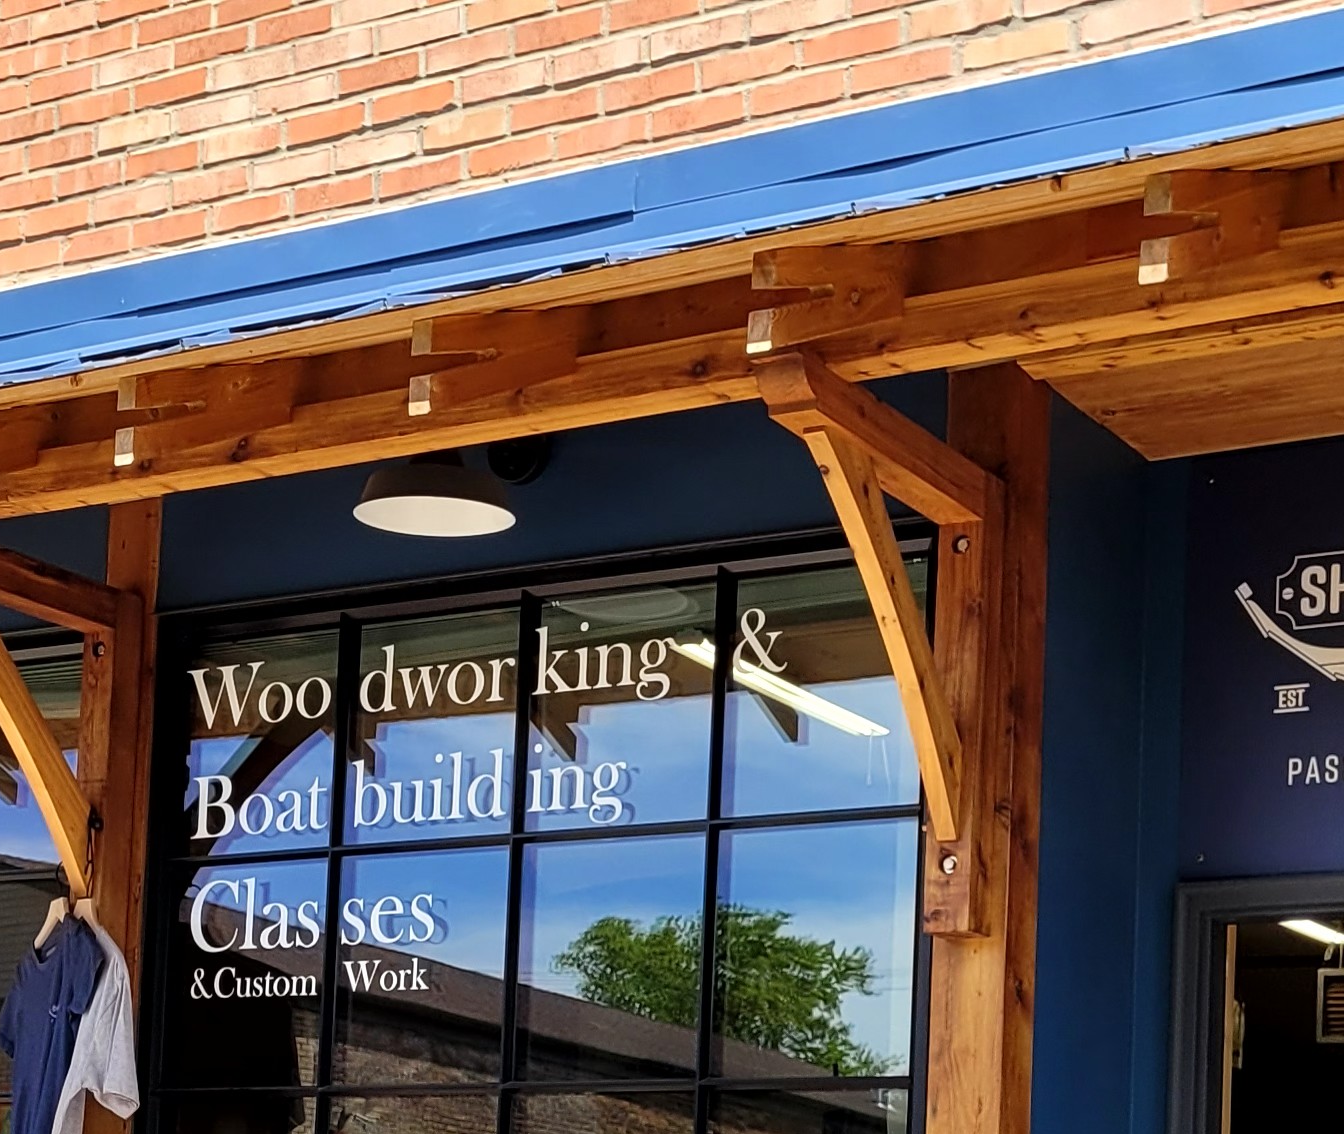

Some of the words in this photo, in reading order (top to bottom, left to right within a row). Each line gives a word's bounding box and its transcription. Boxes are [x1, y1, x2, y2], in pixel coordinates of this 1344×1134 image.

[732, 608, 788, 681] &
[1277, 688, 1306, 708] EST
[190, 774, 328, 839] Boat
[344, 957, 429, 994] Work
